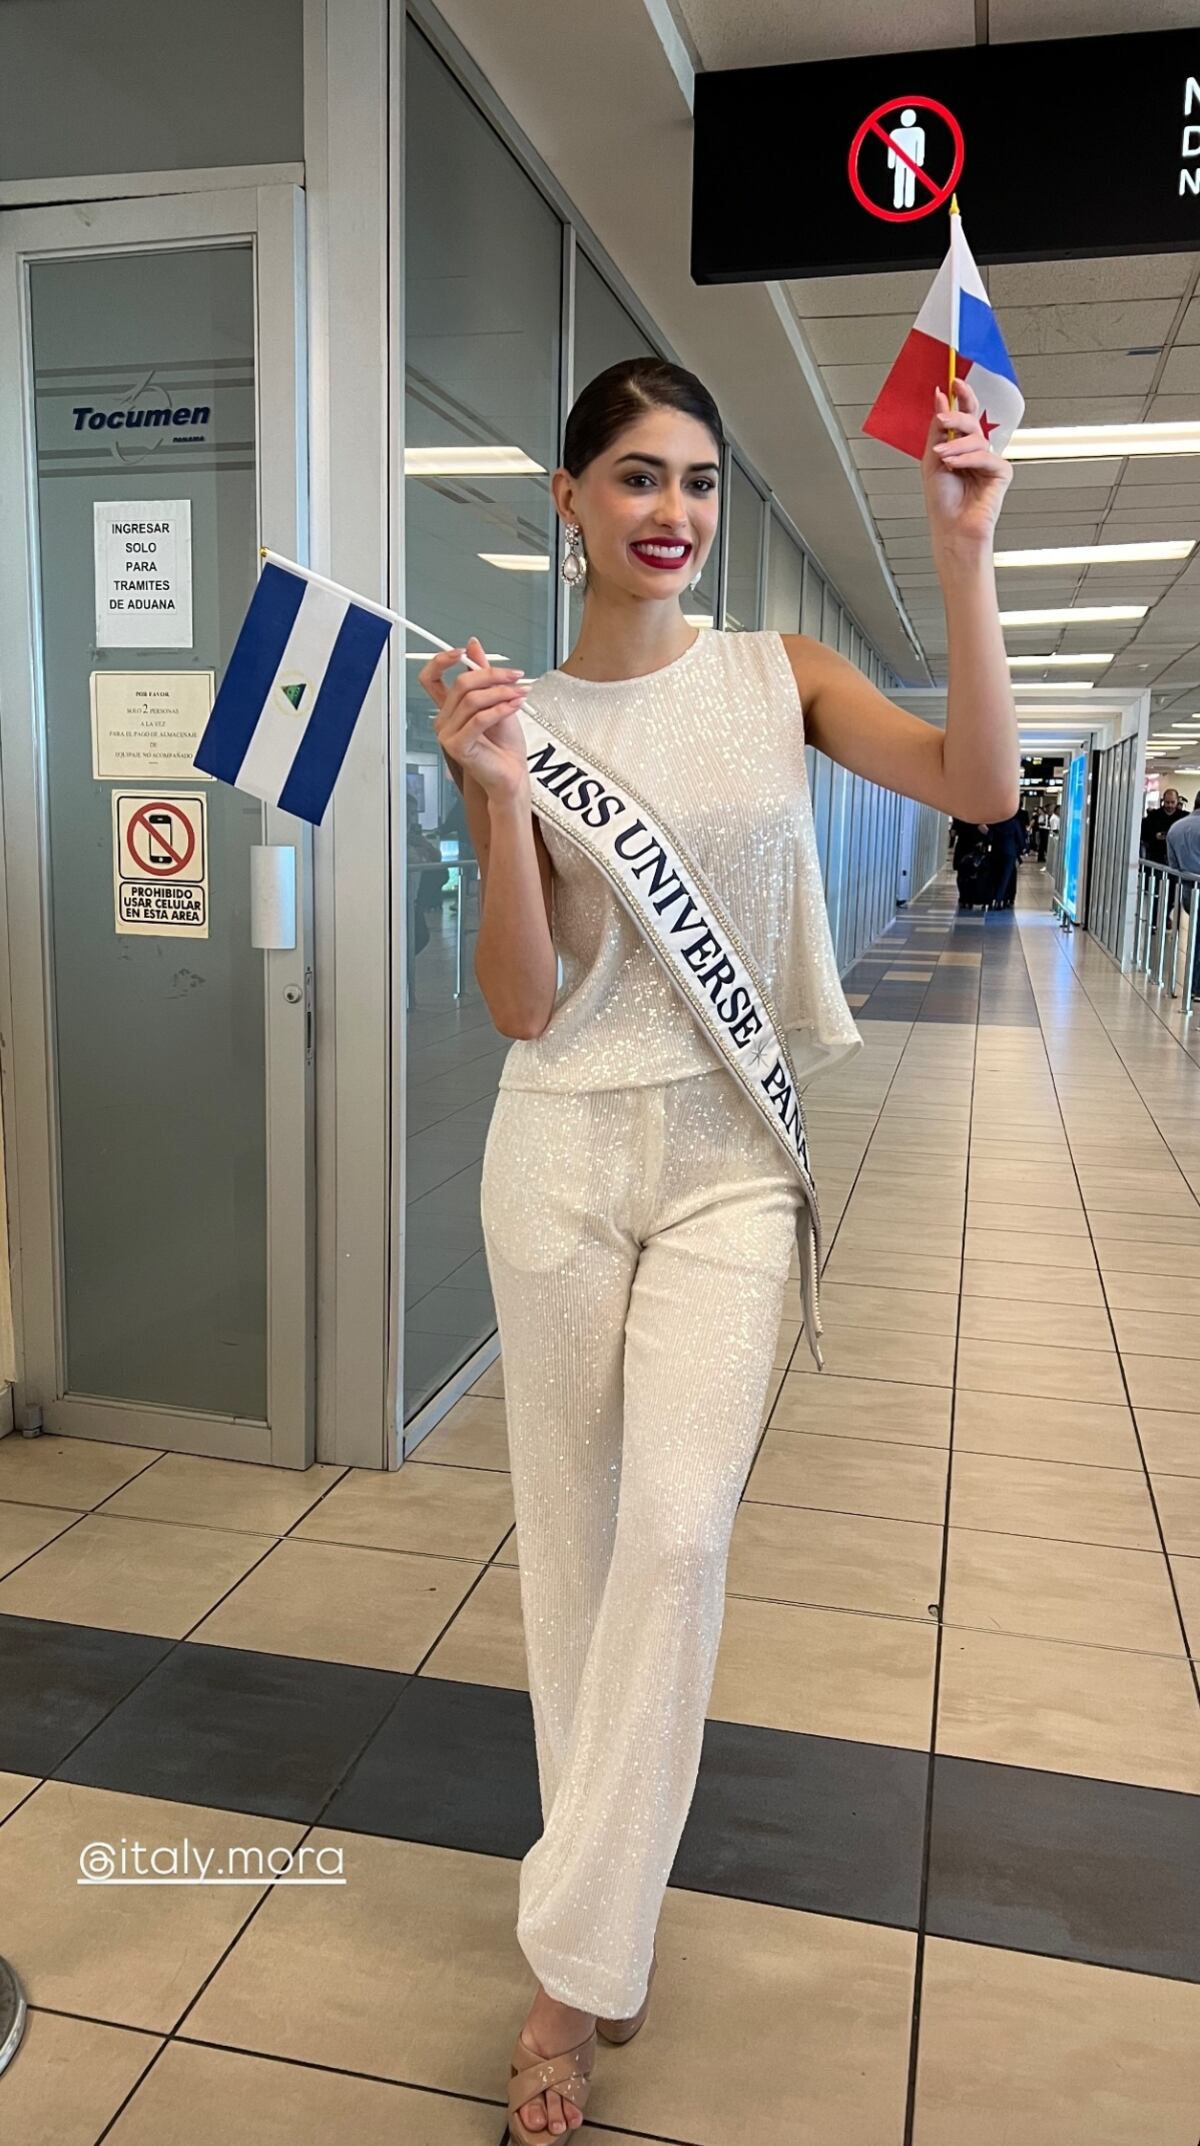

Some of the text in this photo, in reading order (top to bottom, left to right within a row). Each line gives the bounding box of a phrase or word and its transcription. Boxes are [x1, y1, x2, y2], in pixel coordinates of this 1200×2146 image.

[73, 406, 211, 431] Tocumen
[112, 523, 170, 534] INGRESAR
[125, 542, 157, 553] SOLO
[126, 561, 157, 572] PARA
[113, 580, 170, 591] TRAMITES
[109, 599, 175, 610] DE ADUANA
[143, 703, 148, 714] 2
[131, 887, 193, 899] PROHIBIDO
[124, 897, 201, 911] USAR CELULAR
[126, 908, 200, 921] EN ESTA AREA
[527, 742, 814, 1190] MISS UNIVERSE PANA
